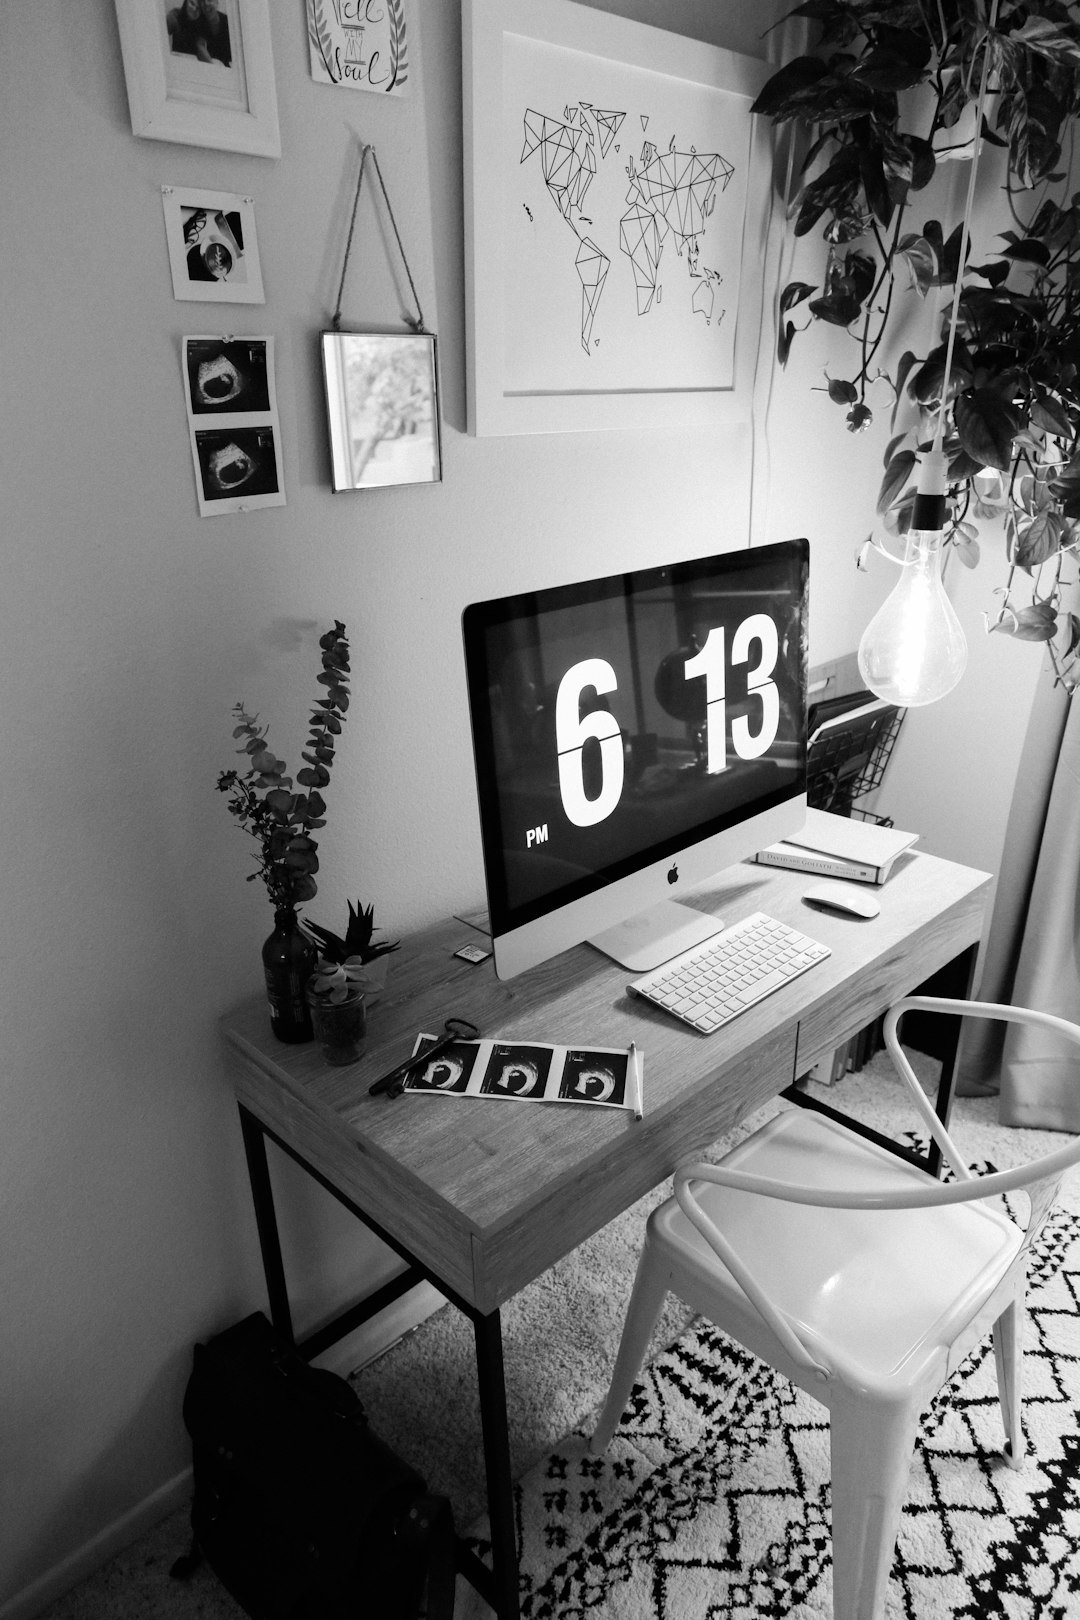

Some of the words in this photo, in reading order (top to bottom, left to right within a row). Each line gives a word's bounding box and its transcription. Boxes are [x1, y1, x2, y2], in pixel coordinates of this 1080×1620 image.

[345, 38, 363, 62] MY
[334, 47, 390, 85] Soul
[556, 658, 624, 827] 6
[684, 613, 780, 775] 13
[526, 824, 548, 848] PM
